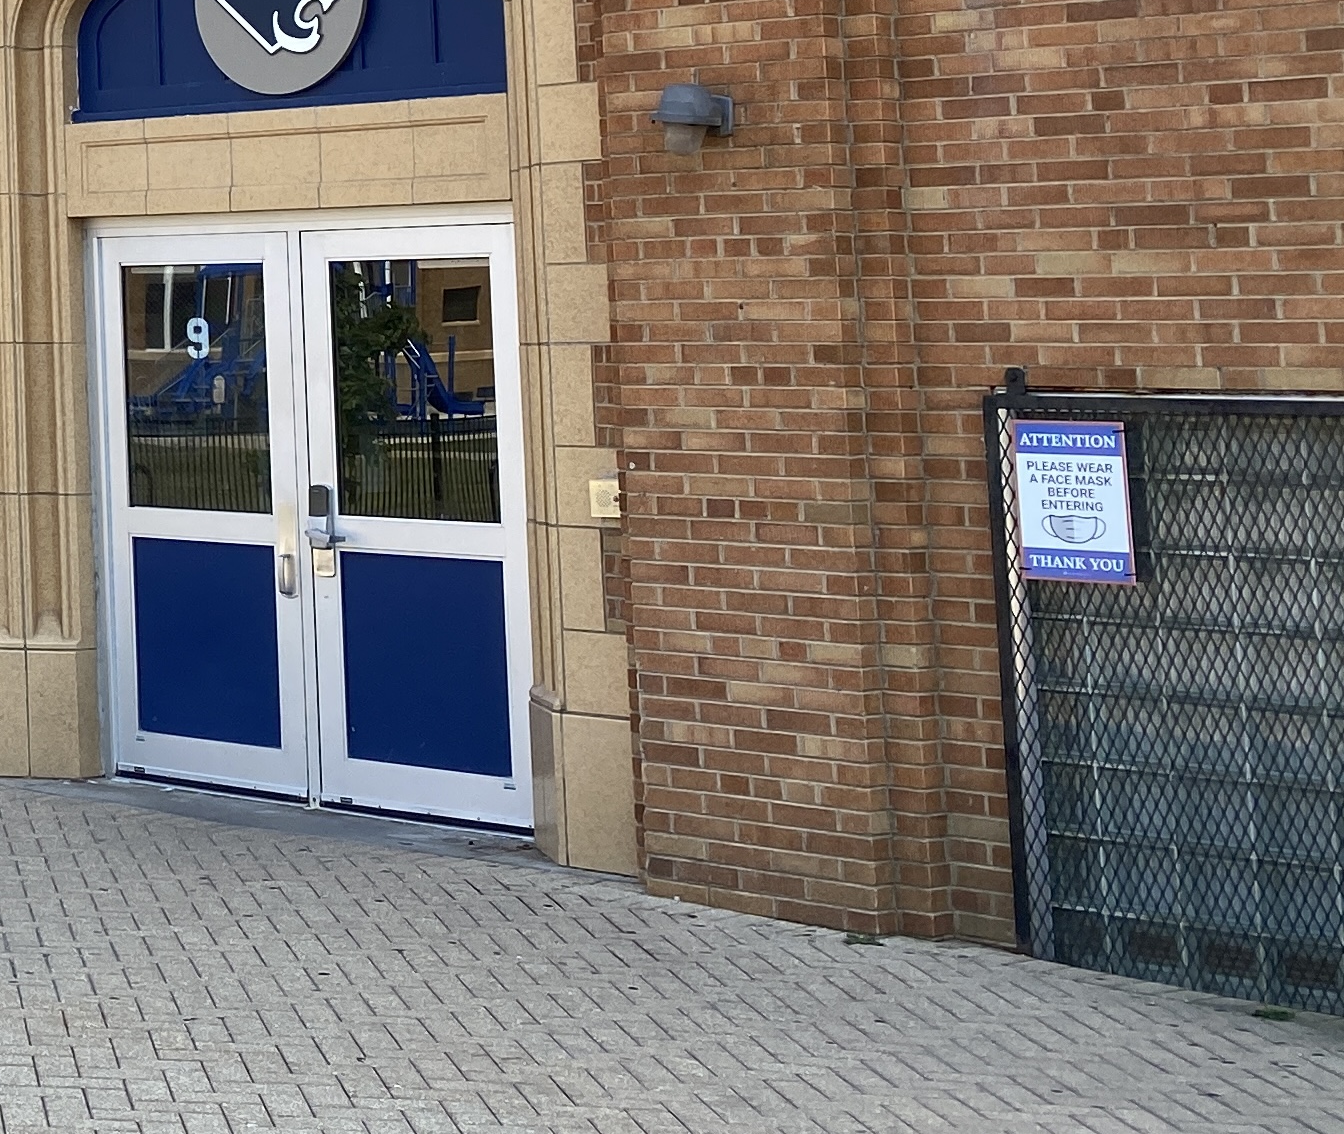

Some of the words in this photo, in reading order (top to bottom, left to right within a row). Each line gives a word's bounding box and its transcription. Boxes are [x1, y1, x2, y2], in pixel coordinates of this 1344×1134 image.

[187, 318, 210, 359] 9
[1019, 433, 1116, 448] ATTENTION
[1026, 460, 1073, 472] PLEASE
[1077, 462, 1113, 474] WEAR
[1029, 474, 1038, 484] A
[1041, 474, 1072, 485] FACE
[1075, 475, 1112, 486] MASK
[1047, 487, 1095, 499] BEFORE
[1041, 500, 1104, 512] ENTERING
[1029, 554, 1087, 570] THANK
[1089, 558, 1124, 572] YOU
